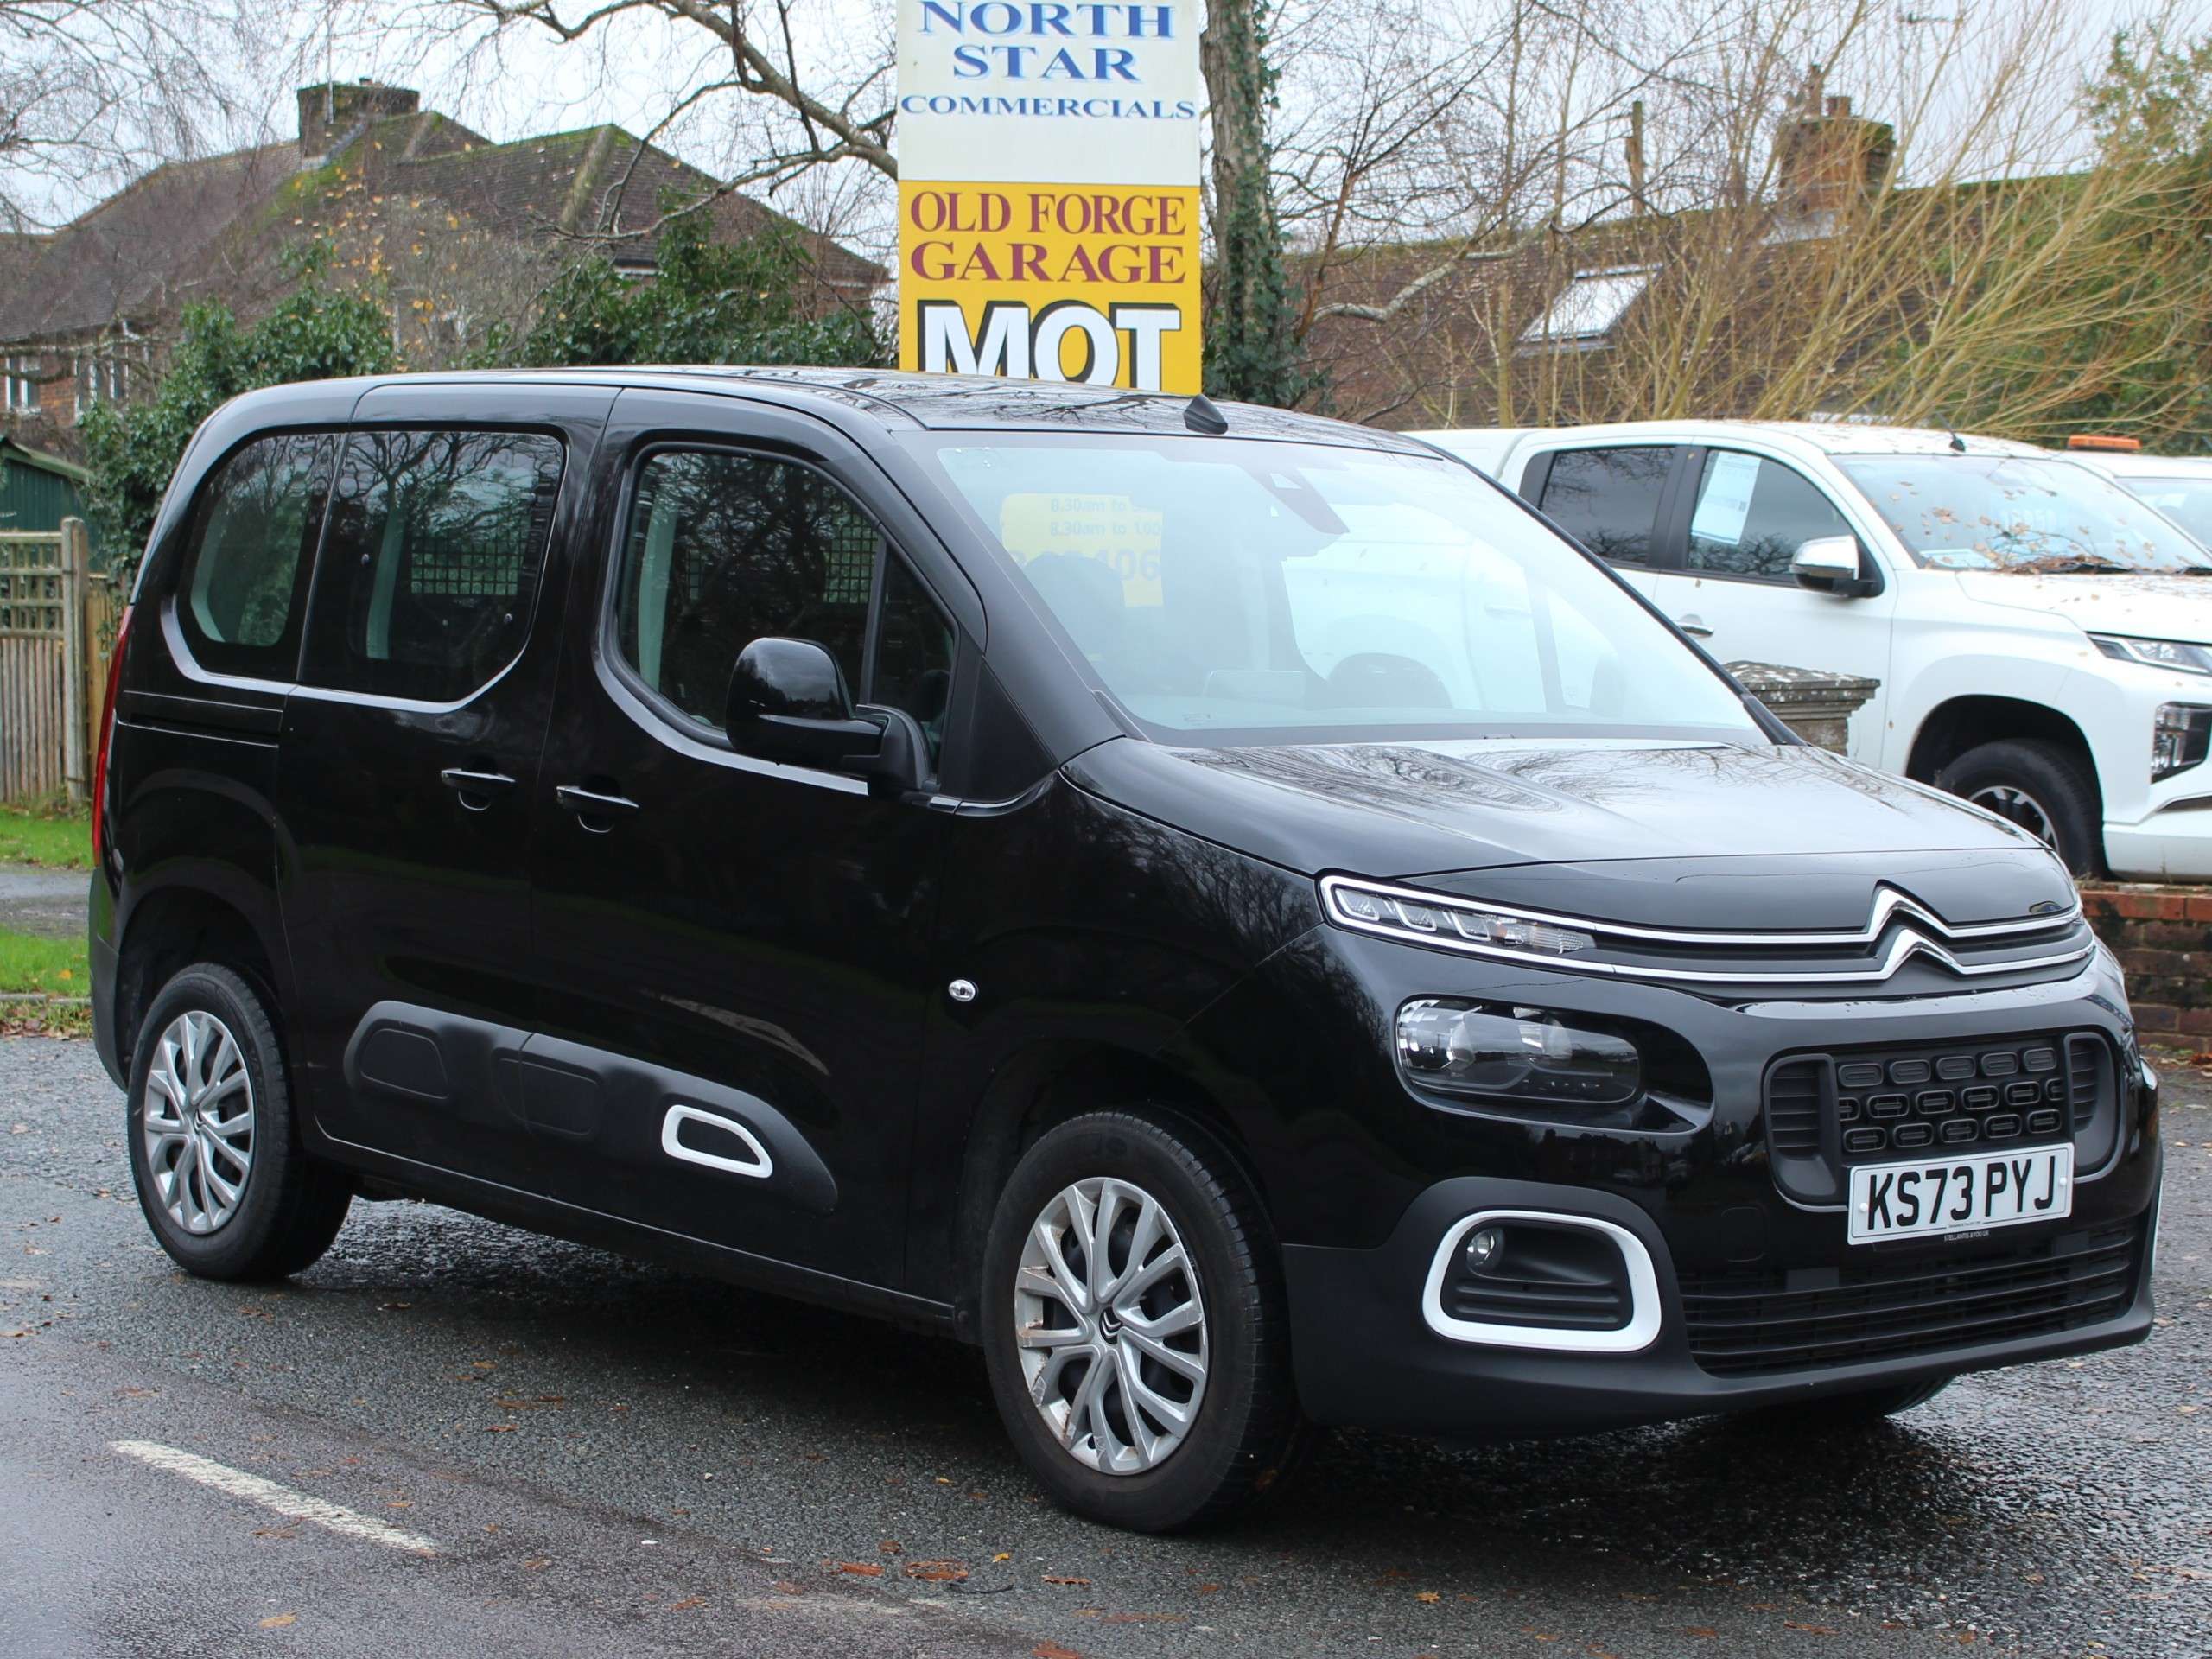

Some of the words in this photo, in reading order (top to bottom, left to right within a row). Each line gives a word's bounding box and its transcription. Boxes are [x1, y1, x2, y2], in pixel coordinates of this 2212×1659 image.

[917, 1, 1176, 39] NORTH
[953, 44, 1141, 82] STAR
[900, 94, 1196, 120] COMMERCIALS
[911, 191, 1011, 232] OLD
[1027, 193, 1186, 237] FORGE
[911, 240, 1186, 285] GARAGE
[917, 299, 1182, 392] MOT
[1867, 1166, 1974, 1230] KS73
[1985, 1155, 2056, 1217] PYJ
